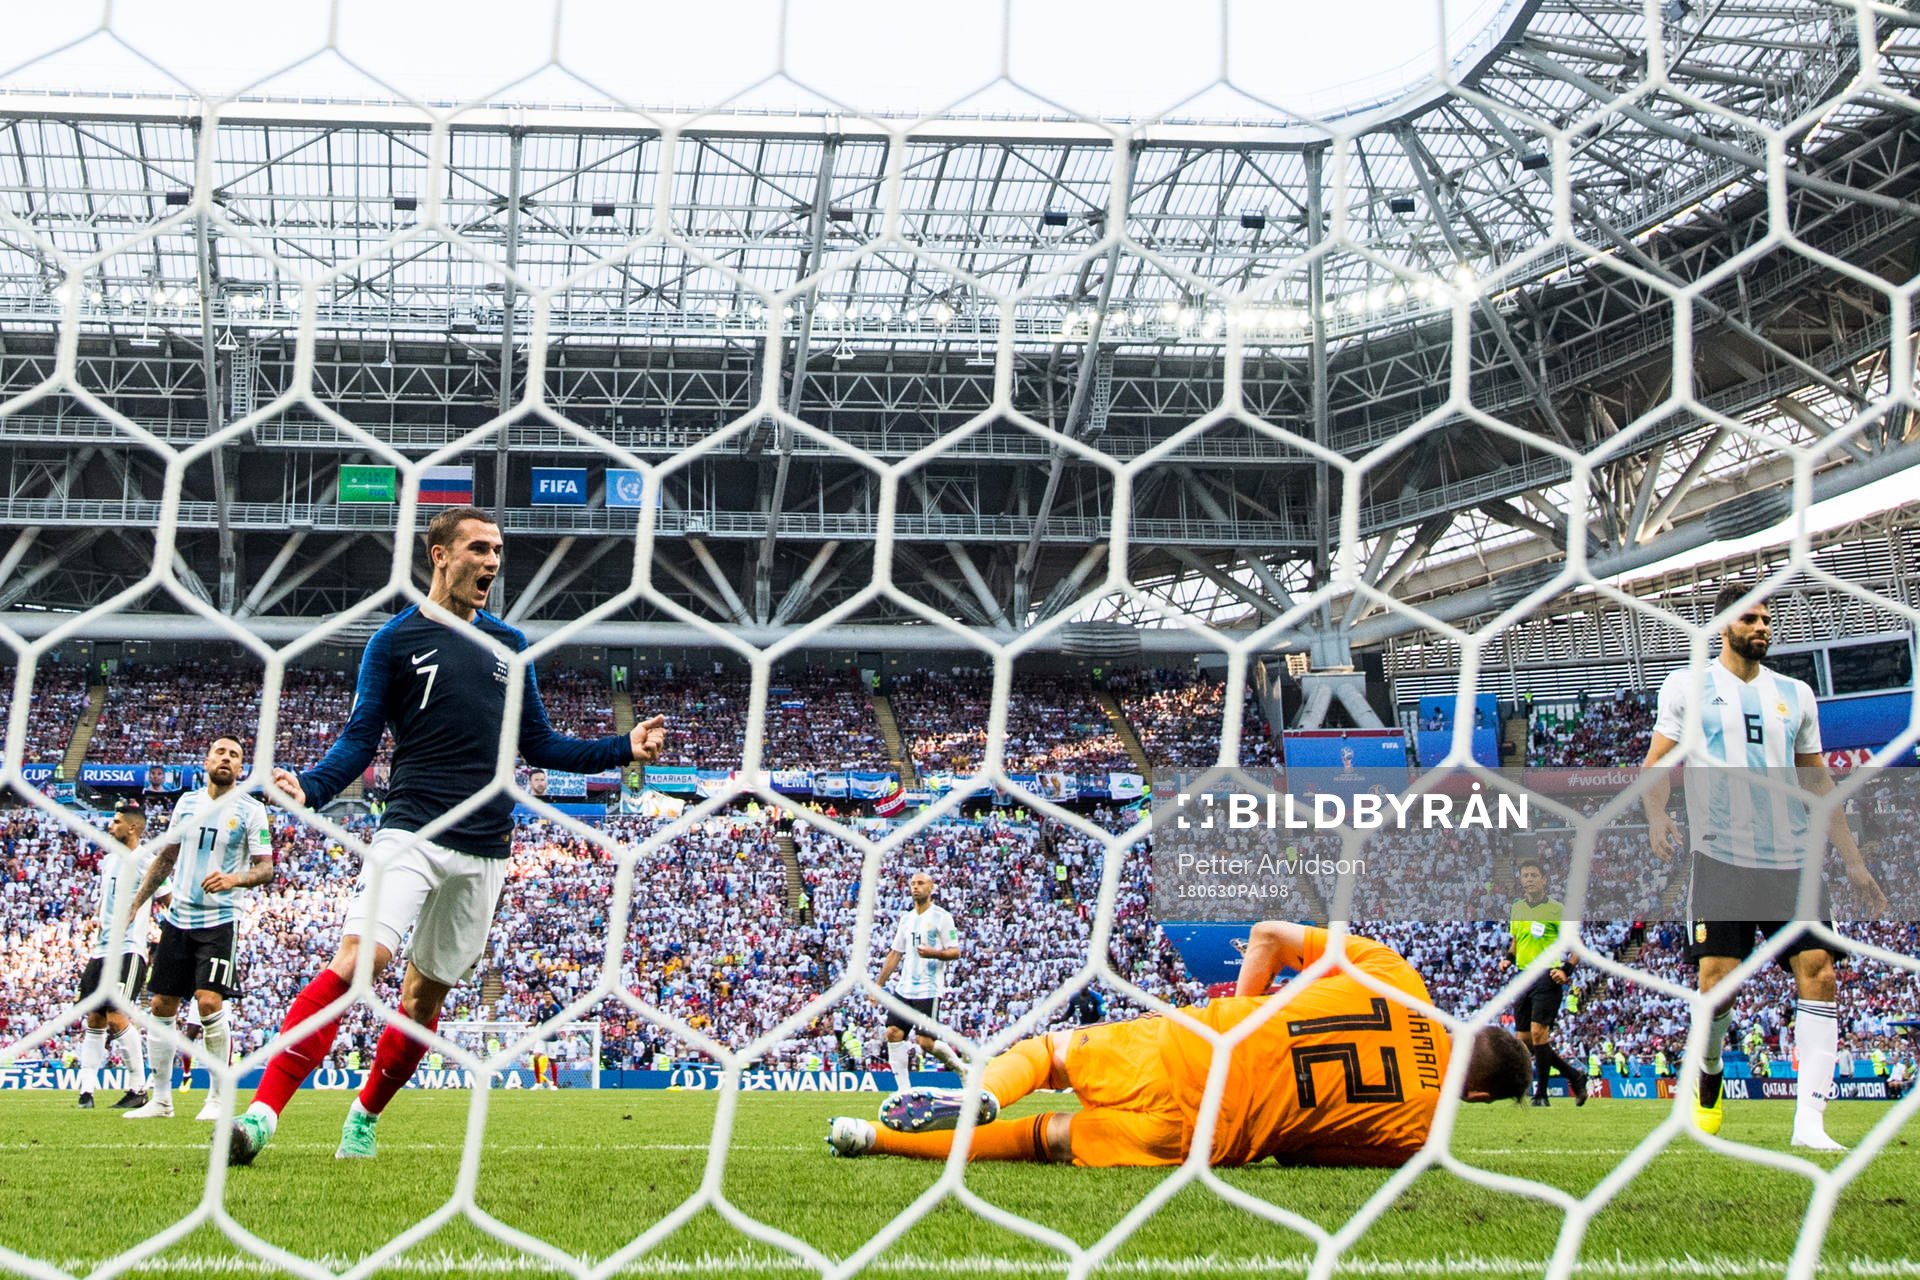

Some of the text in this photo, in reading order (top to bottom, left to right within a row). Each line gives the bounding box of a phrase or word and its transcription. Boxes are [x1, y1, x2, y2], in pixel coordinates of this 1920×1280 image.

[540, 480, 578, 494] FIFA
[416, 664, 439, 710] 7
[1744, 714, 1763, 744] 6
[23, 768, 52, 781] CUP
[83, 769, 135, 782] RUSSIA
[1568, 771, 1640, 787] #worldcu
[209, 958, 229, 984] 17
[1287, 998, 1405, 1108] 12
[0, 1068, 54, 1090] 万达
[418, 1069, 523, 1090] WANA
[773, 1071, 879, 1092] WANDA
[1723, 1079, 1749, 1099] VISA
[1762, 1082, 1788, 1097] QATAR
